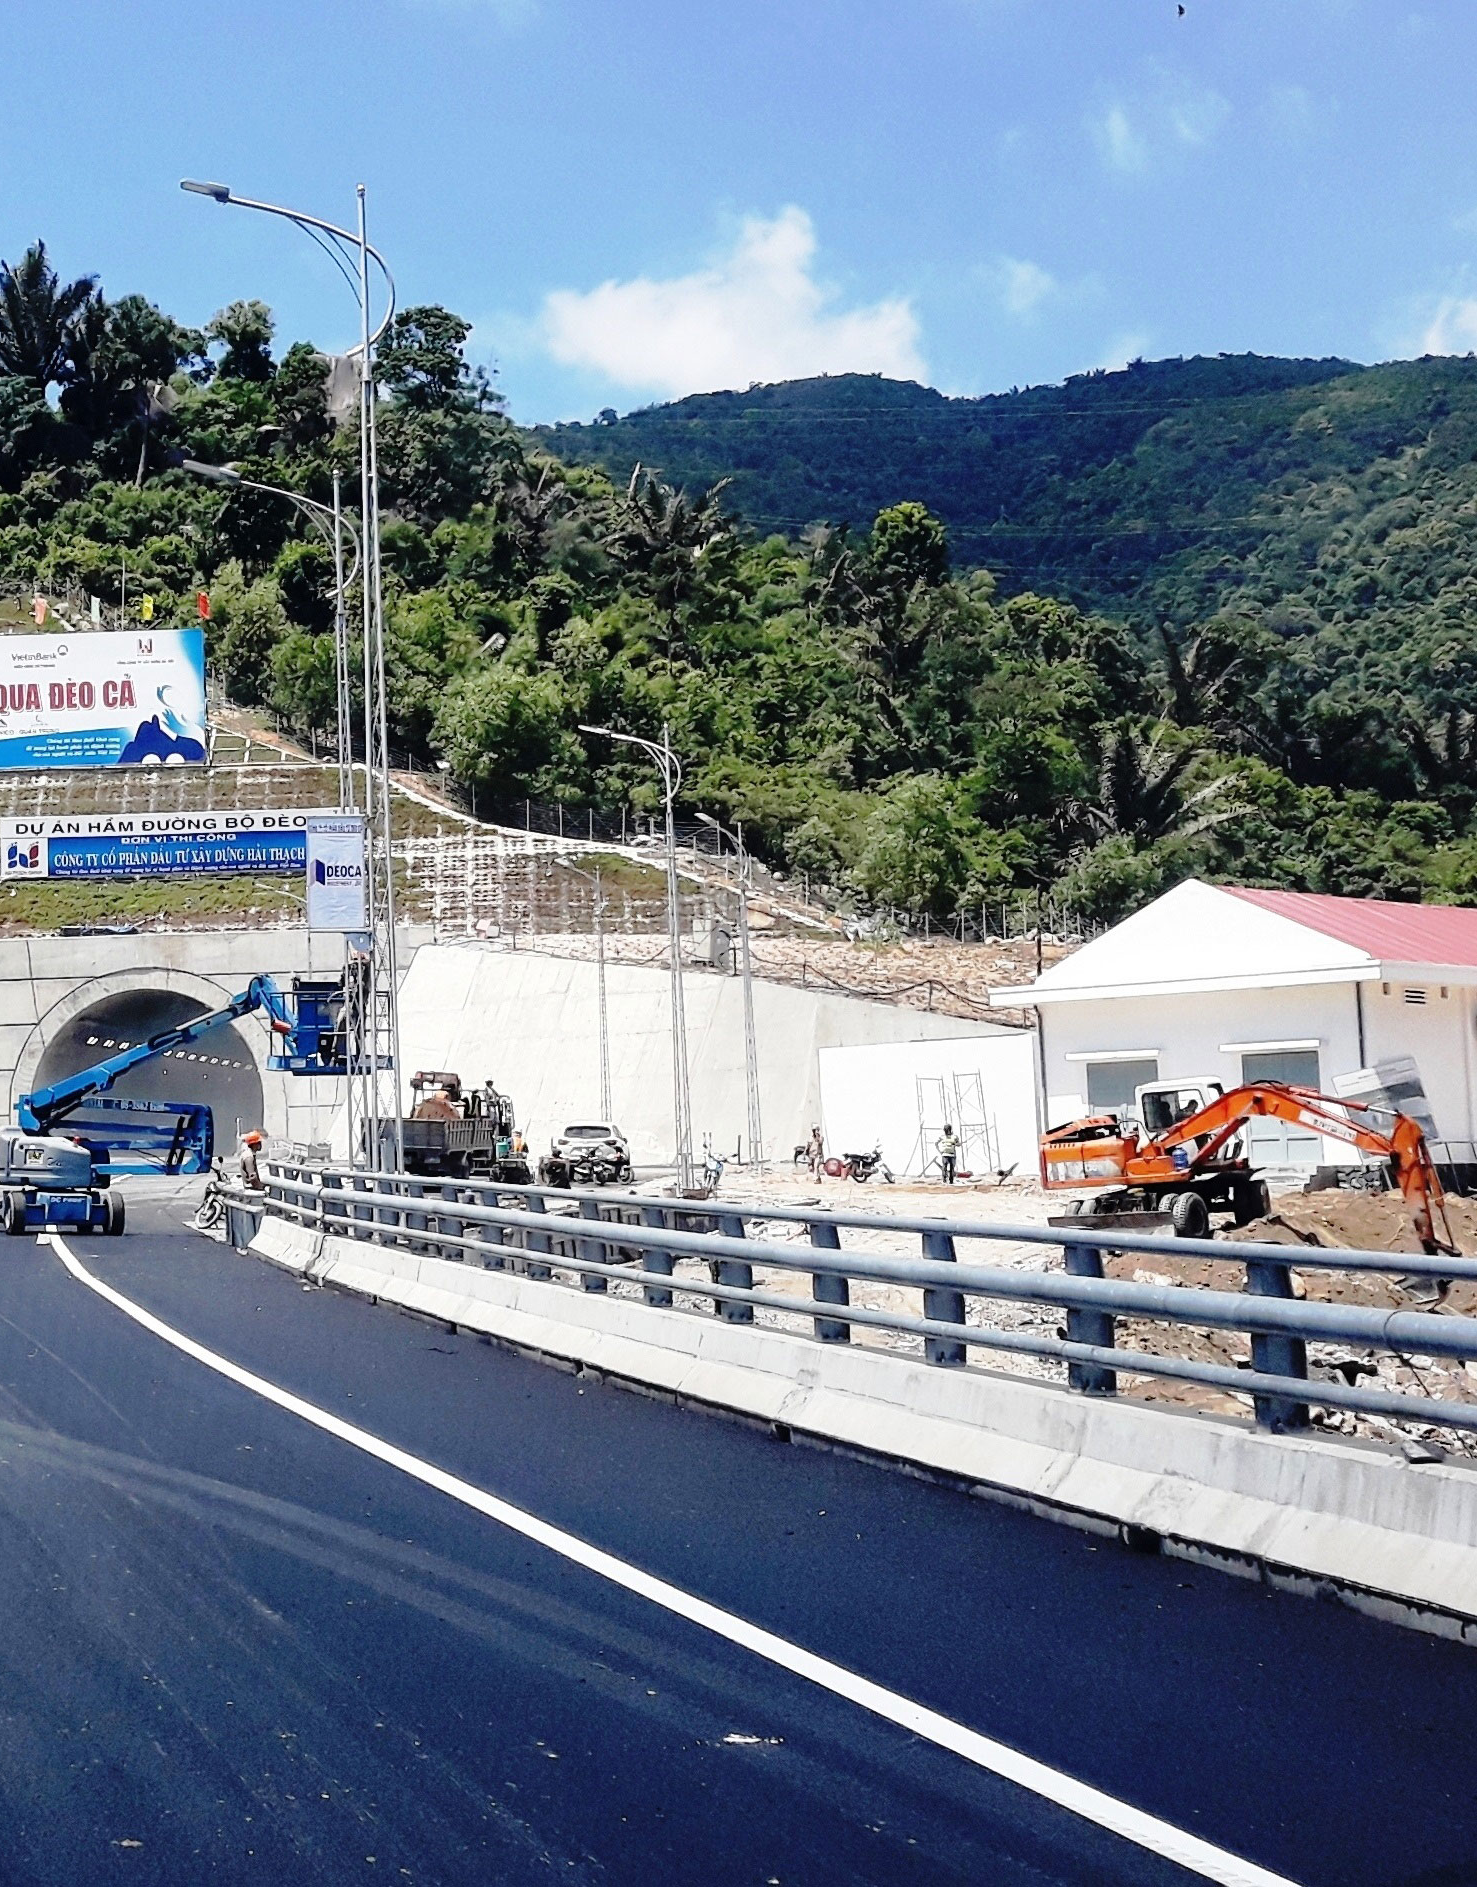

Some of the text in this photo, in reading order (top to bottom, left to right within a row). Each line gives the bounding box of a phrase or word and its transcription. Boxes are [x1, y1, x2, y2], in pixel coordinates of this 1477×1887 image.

[49, 678, 95, 710] ĐÈO
[102, 673, 137, 708] CẢ
[15, 822, 45, 836] DỰ
[51, 820, 80, 834] ÁN
[142, 815, 217, 831] ĐƯỜNG
[225, 814, 255, 830] BỘ
[262, 813, 307, 828] ĐÈO
[54, 851, 83, 867] CÔNG
[86, 853, 99, 866] TY
[102, 847, 116, 865] CỔ
[175, 848, 190, 864] TƯ
[191, 847, 212, 863] XÂY
[214, 845, 245, 865] DỰNG
[247, 843, 266, 861] HẢI
[269, 847, 306, 864] THẠCH
[327, 865, 362, 878] DEOCA
